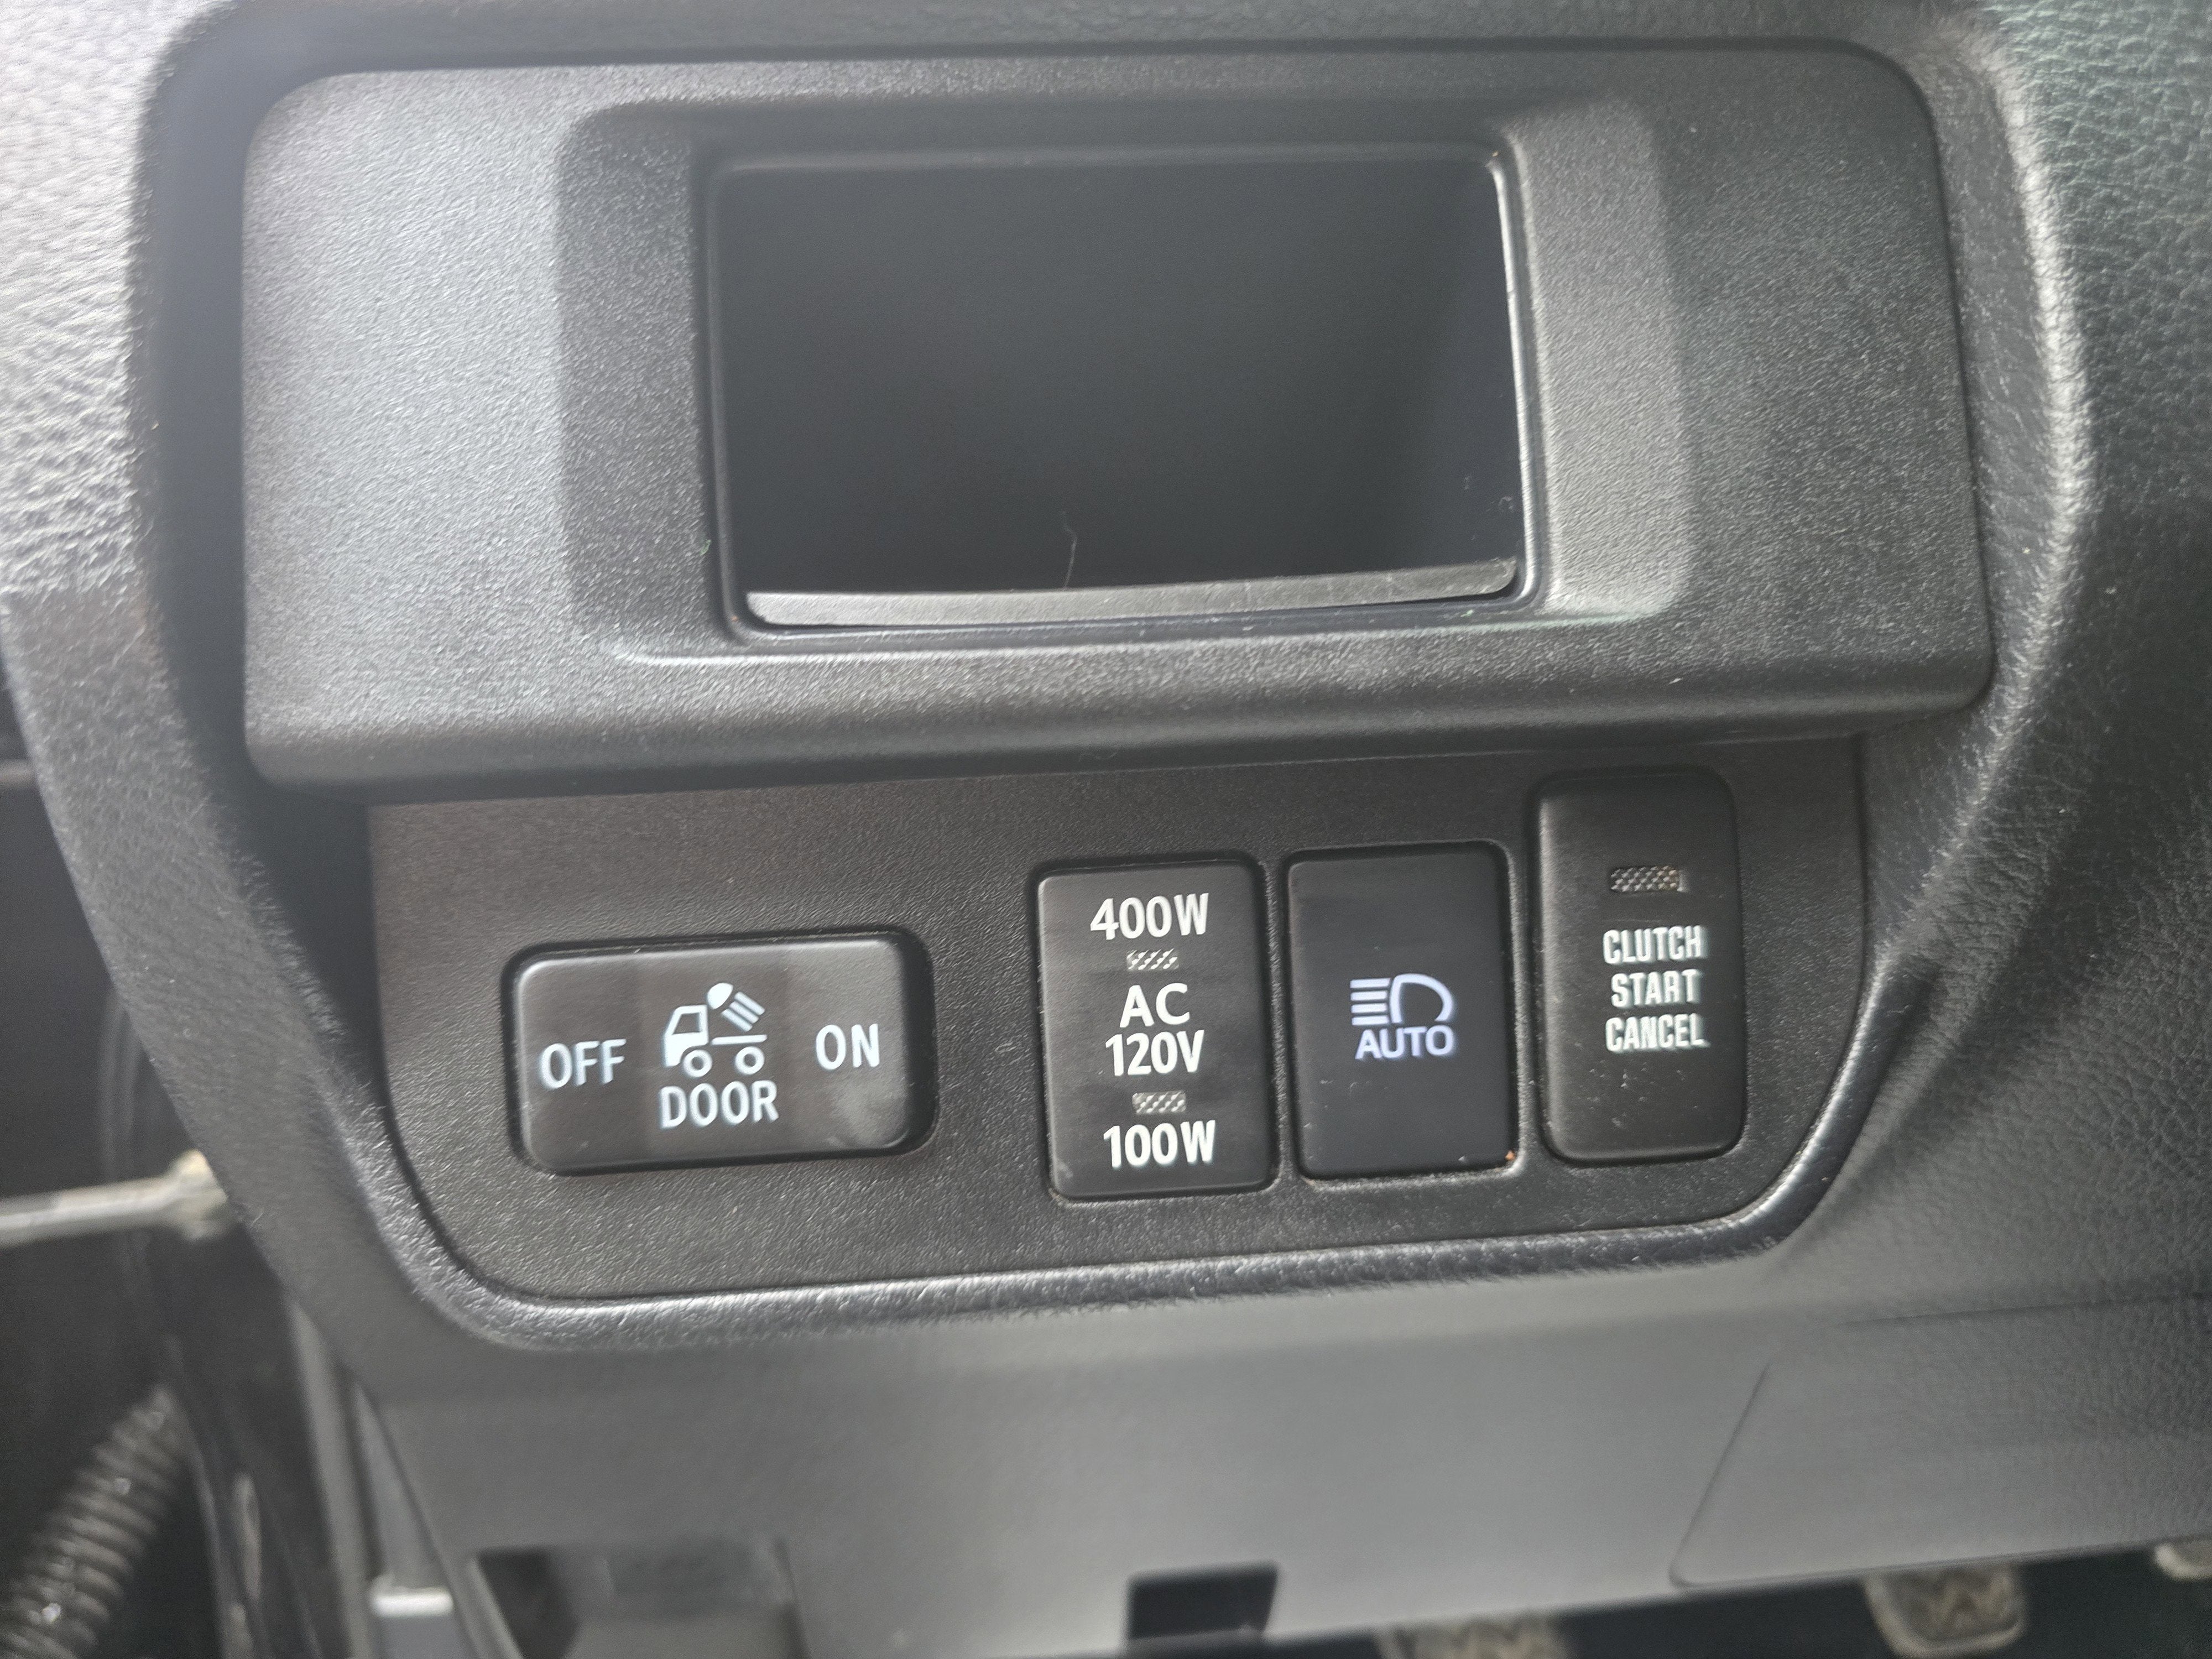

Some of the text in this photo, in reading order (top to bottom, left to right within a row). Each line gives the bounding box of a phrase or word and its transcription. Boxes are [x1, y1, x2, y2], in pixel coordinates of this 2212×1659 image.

[1090, 893, 1209, 940] 400W
[1603, 925, 1707, 964] CLUTCH
[1119, 983, 1190, 1028] AC
[1611, 969, 1700, 1008] START
[815, 1023, 880, 1071] ON
[1105, 1029, 1204, 1076] 120V
[1355, 1025, 1454, 1060] AUTO
[1605, 1013, 1708, 1051] CANCEL
[538, 1038, 627, 1089] OFF
[659, 1079, 779, 1129] DOOR
[1103, 1119, 1215, 1168] 100W
